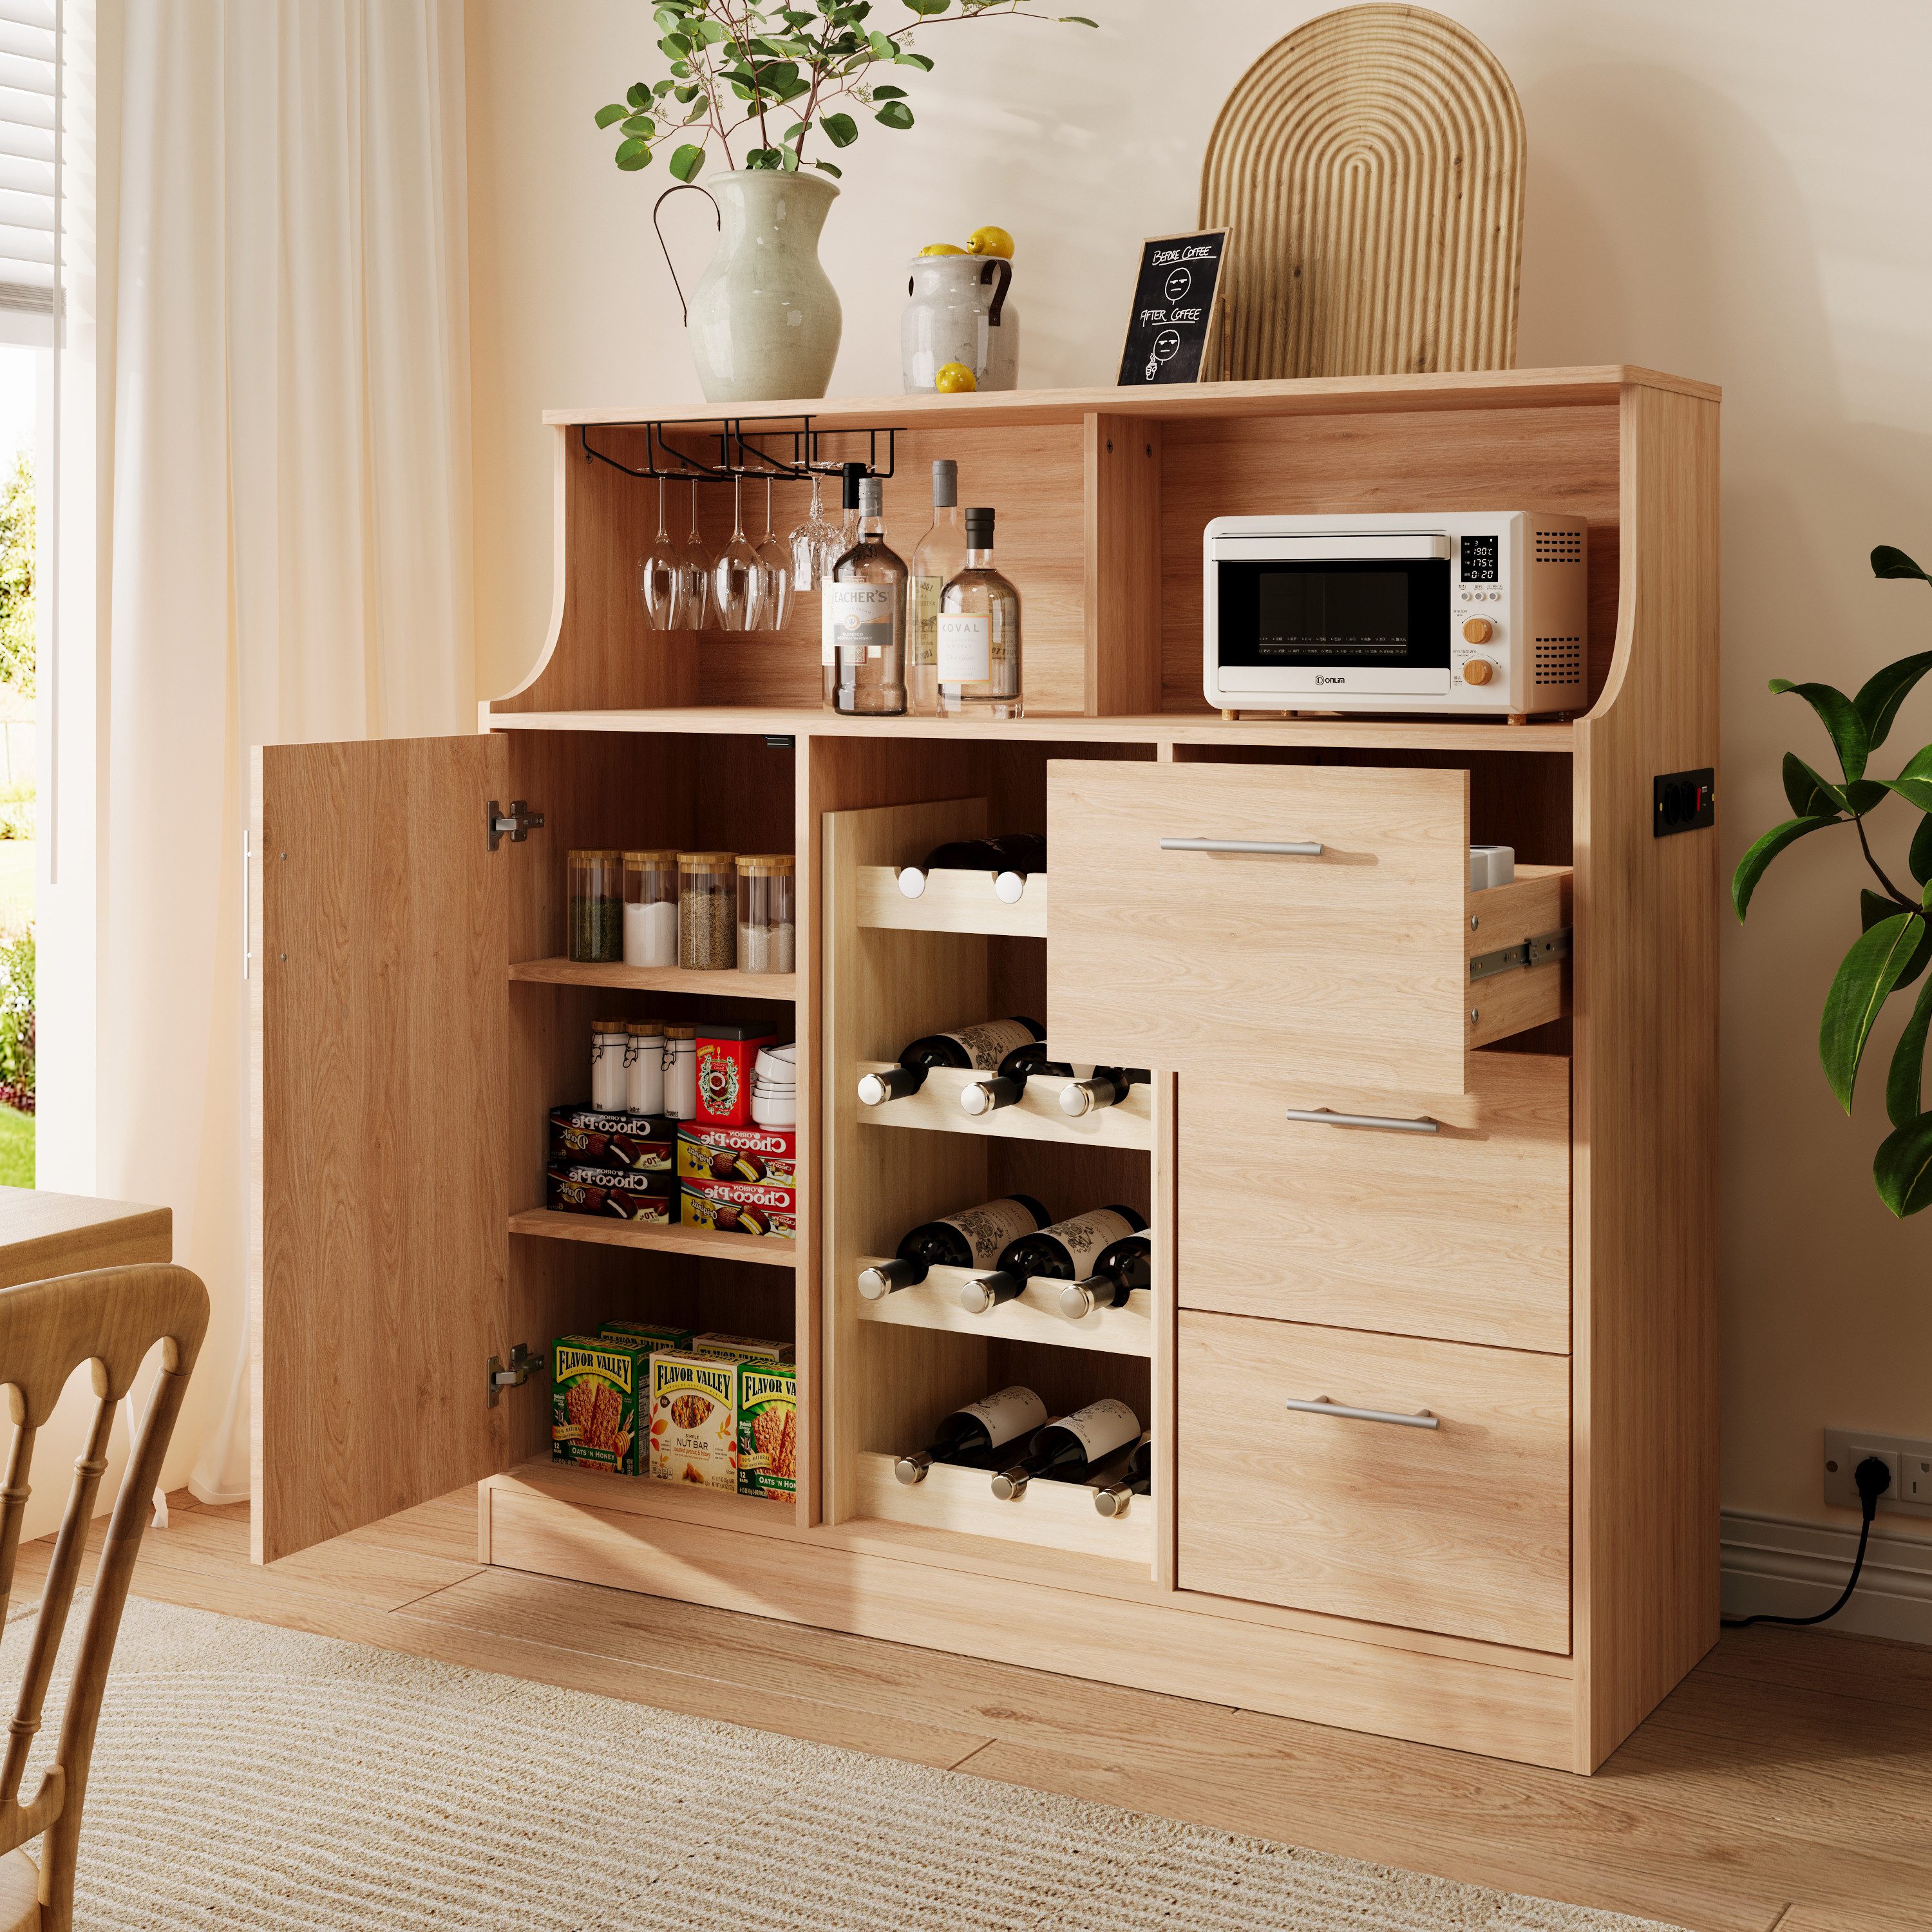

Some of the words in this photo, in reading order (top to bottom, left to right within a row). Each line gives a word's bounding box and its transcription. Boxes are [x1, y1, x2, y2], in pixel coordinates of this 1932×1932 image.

[1152, 249, 1180, 265] BEFORE
[1182, 246, 1212, 259] COFFEE
[1140, 309, 1167, 327] AFTER
[1171, 308, 1202, 321] COFFEE
[834, 590, 887, 603] EACHER'S
[942, 623, 980, 632] KOVAL
[558, 1350, 594, 1377] FLAVOR
[596, 1355, 630, 1386] VALLEY
[657, 1365, 693, 1391] FLAVOR
[696, 1370, 730, 1401] VALLEY
[745, 1376, 782, 1403] FLAVOR
[677, 1438, 692, 1448] NUT
[693, 1441, 708, 1450] BAR
[572, 1447, 587, 1455] OATS
[595, 1451, 615, 1461] HONEY
[759, 1477, 775, 1485] OATS
[784, 1480, 796, 1488] HON
